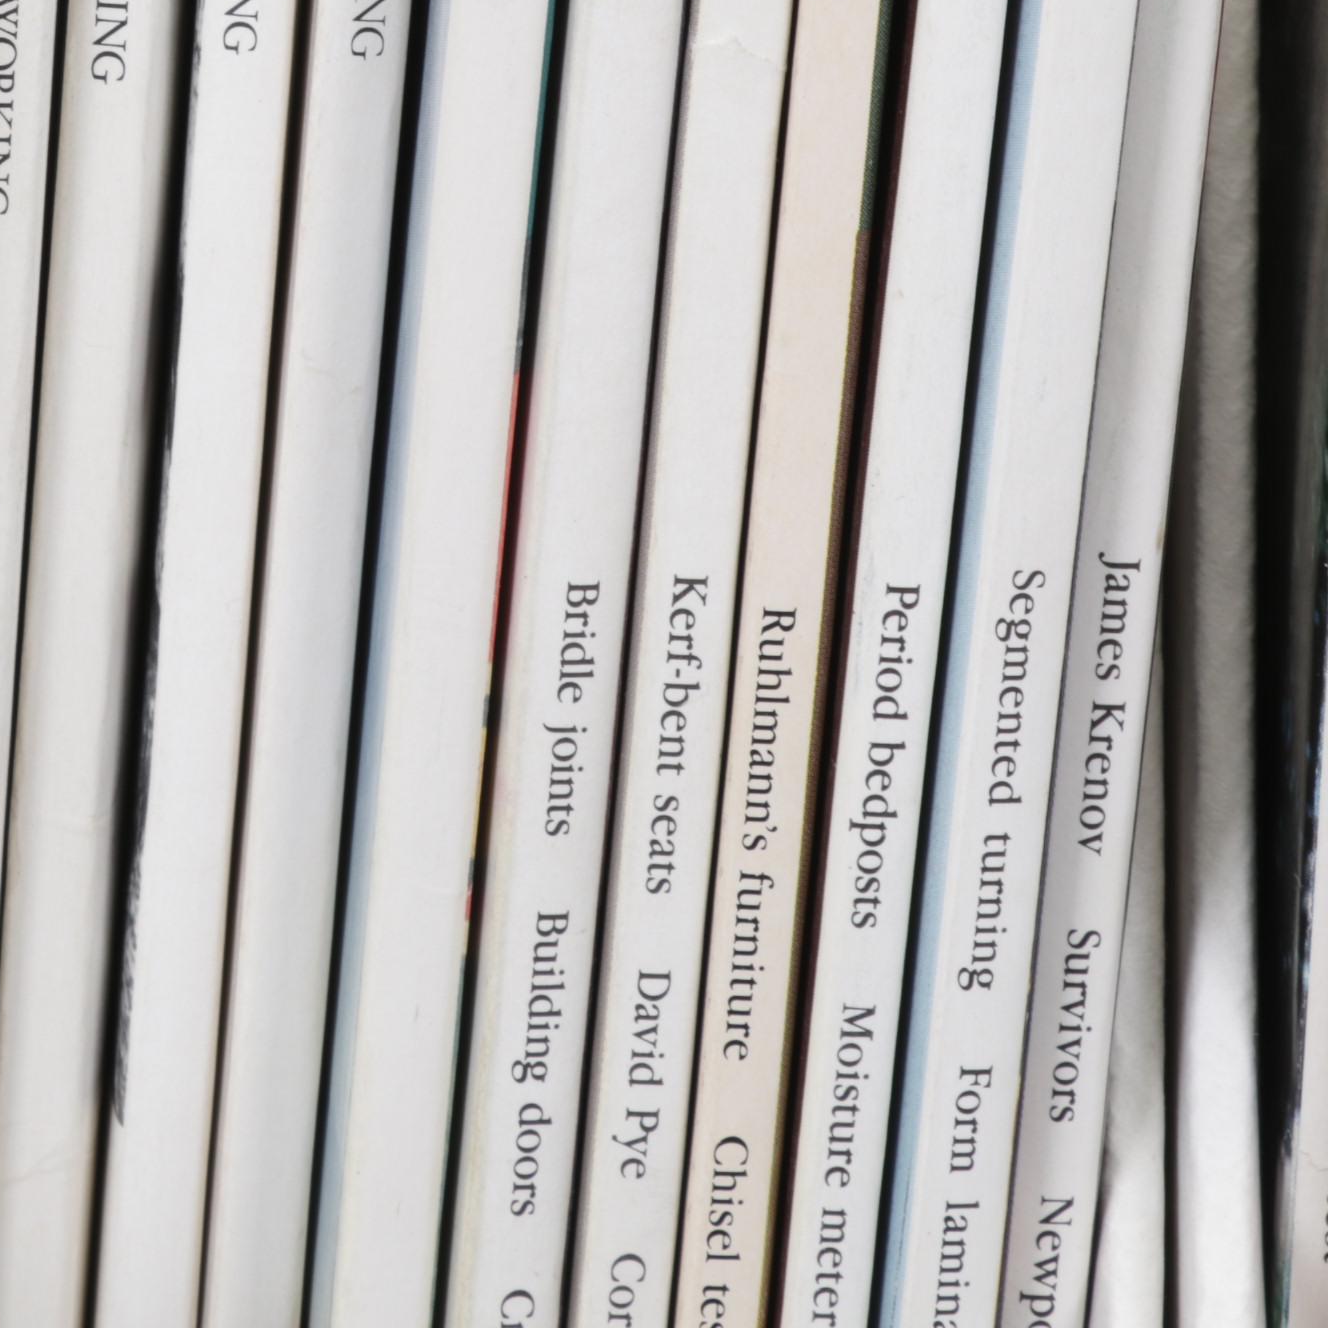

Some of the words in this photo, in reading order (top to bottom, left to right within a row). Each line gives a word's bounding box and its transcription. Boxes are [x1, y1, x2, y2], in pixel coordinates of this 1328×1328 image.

[557, 581, 600, 703] Bridle
[656, 574, 708, 776] Kerf-bent
[872, 583, 920, 720] Period
[1095, 551, 1141, 680] James
[988, 570, 1045, 806] Segmented
[543, 724, 587, 836] joints
[646, 795, 679, 894] seats
[849, 741, 906, 928] bedposts
[1077, 700, 1126, 856] Krenov
[723, 870, 774, 1060] furniture
[957, 832, 1011, 991] turning
[512, 911, 569, 1083] Building
[629, 970, 671, 1086] David
[1049, 929, 1101, 1122] Survivors
[511, 1103, 552, 1216] doors
[612, 1108, 660, 1179] Pye
[824, 1004, 876, 1188] Moisture
[950, 1066, 993, 1173] Form
[706, 1136, 749, 1262] Chisel
[812, 1208, 847, 1328] meter
